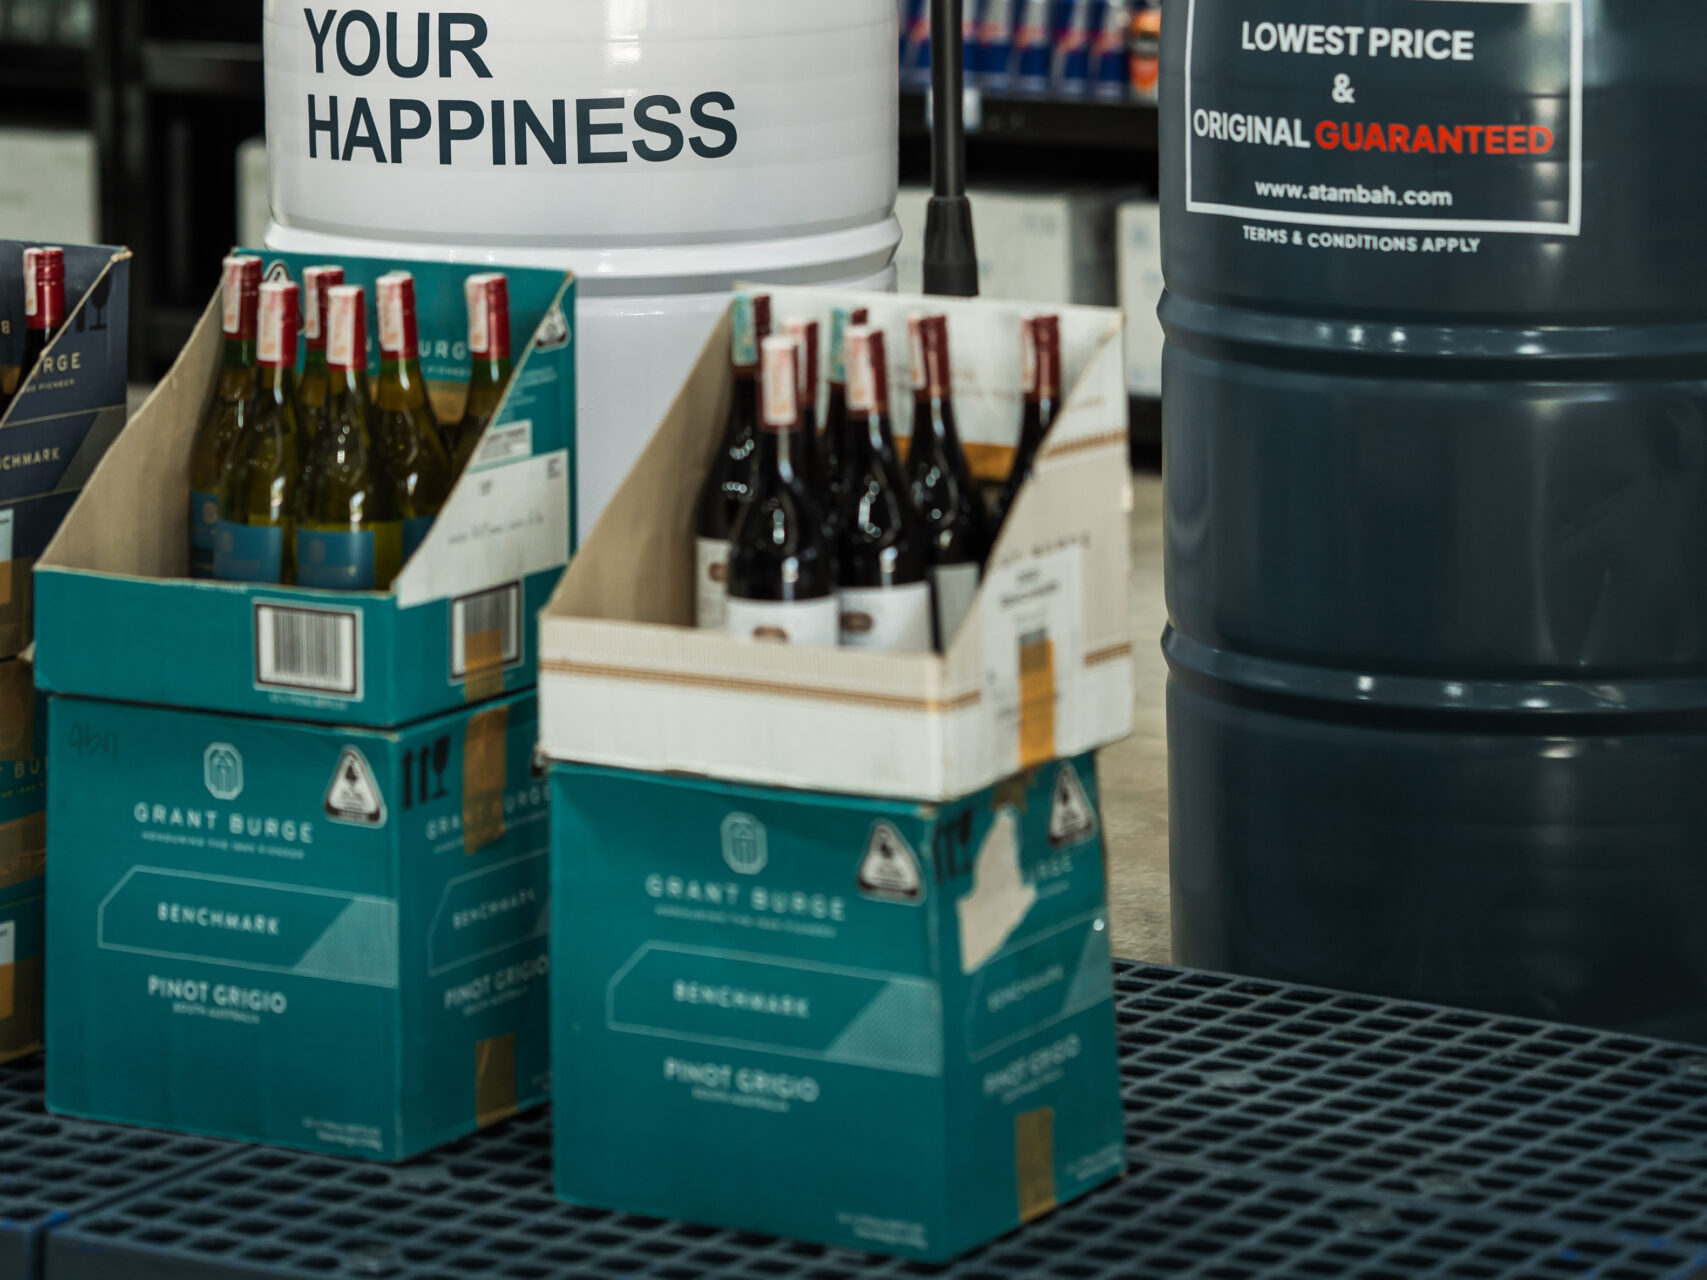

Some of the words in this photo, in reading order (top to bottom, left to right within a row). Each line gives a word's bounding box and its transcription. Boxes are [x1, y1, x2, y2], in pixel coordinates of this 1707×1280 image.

[303, 7, 494, 79] YOUR
[1241, 21, 1365, 57] LOWEST
[1368, 28, 1475, 61] PRICE
[1331, 73, 1355, 103] &
[307, 90, 738, 166] HAPPINESS
[1193, 109, 1311, 148] ORIGINAL
[1314, 121, 1554, 155] GUARANTEED
[1254, 180, 1453, 207] www.atambah.com
[1242, 225, 1289, 245] TERMS
[1291, 230, 1304, 247] &
[1307, 232, 1418, 253] CONDITIONS
[1421, 237, 1481, 254] APPLY
[44, 352, 81, 374] RGE
[418, 340, 467, 360] URG
[0, 447, 60, 470] CHMARK
[133, 801, 218, 831] GRANT
[229, 813, 314, 844] BURGE
[645, 872, 740, 905] GRANT
[751, 886, 846, 921] BURGE
[157, 902, 280, 935] BENCHMARK
[148, 975, 211, 1003] PINOT
[213, 984, 288, 1014] GRIGIO
[672, 978, 810, 1019] BENCHMARK
[663, 1055, 732, 1089] PINOT
